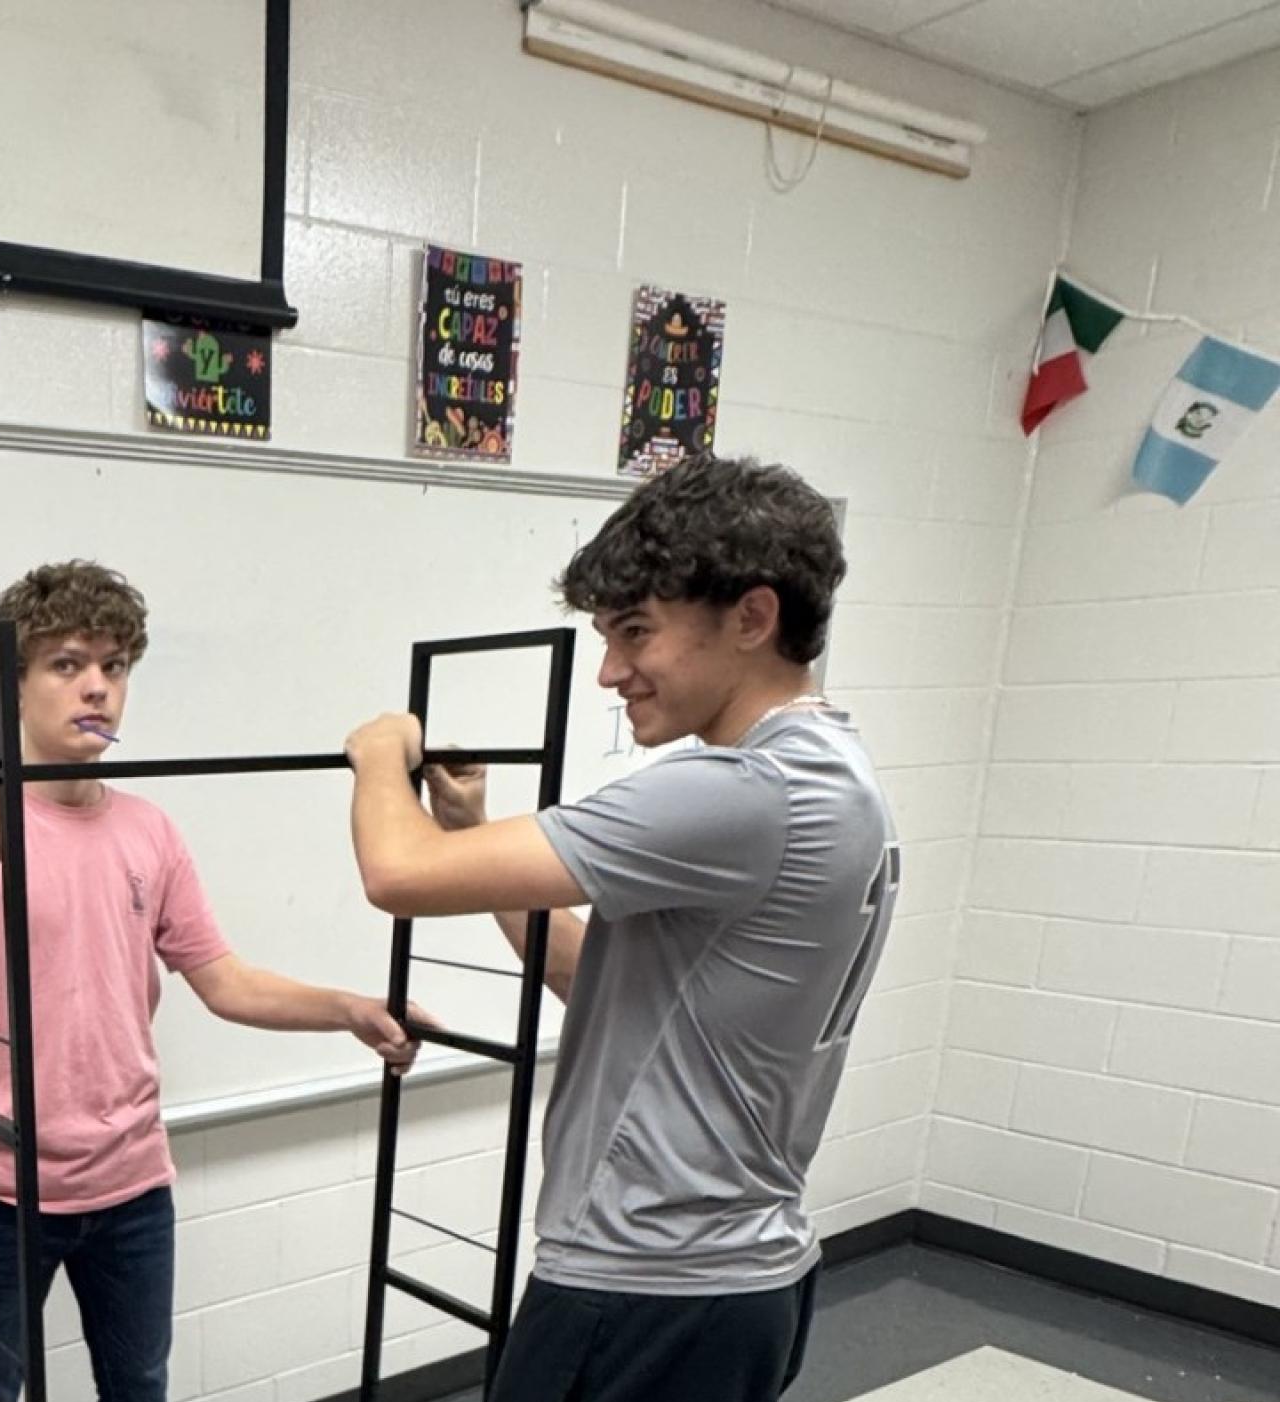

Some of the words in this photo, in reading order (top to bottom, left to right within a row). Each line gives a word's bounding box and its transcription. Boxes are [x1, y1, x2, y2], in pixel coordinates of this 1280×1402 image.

[438, 307, 498, 346] CAPAZ
[438, 342, 456, 367] de
[636, 379, 704, 420] PODER
